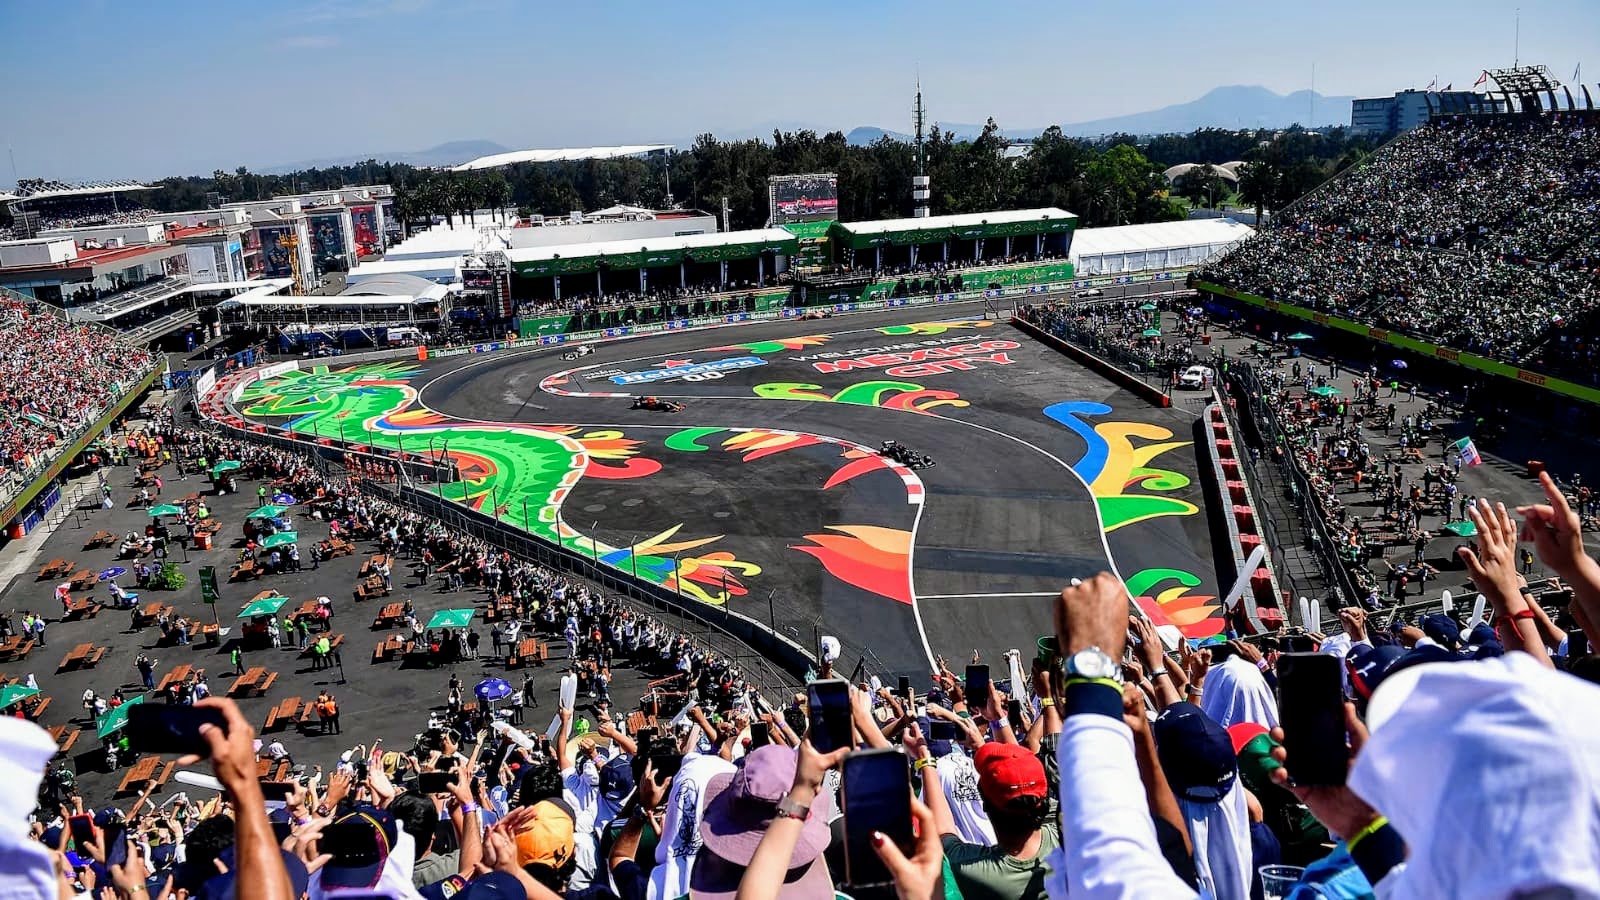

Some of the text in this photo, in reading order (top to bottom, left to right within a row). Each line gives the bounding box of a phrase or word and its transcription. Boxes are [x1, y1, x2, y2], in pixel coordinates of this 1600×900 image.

[569, 332, 601, 341] Heineken
[632, 324, 663, 333] Heineken
[435, 348, 469, 358] Heineken
[789, 334, 992, 362] WELCOME BACK
[812, 340, 1022, 374] MEXICO
[624, 358, 756, 384] Heineken
[885, 352, 1016, 378] CITY
